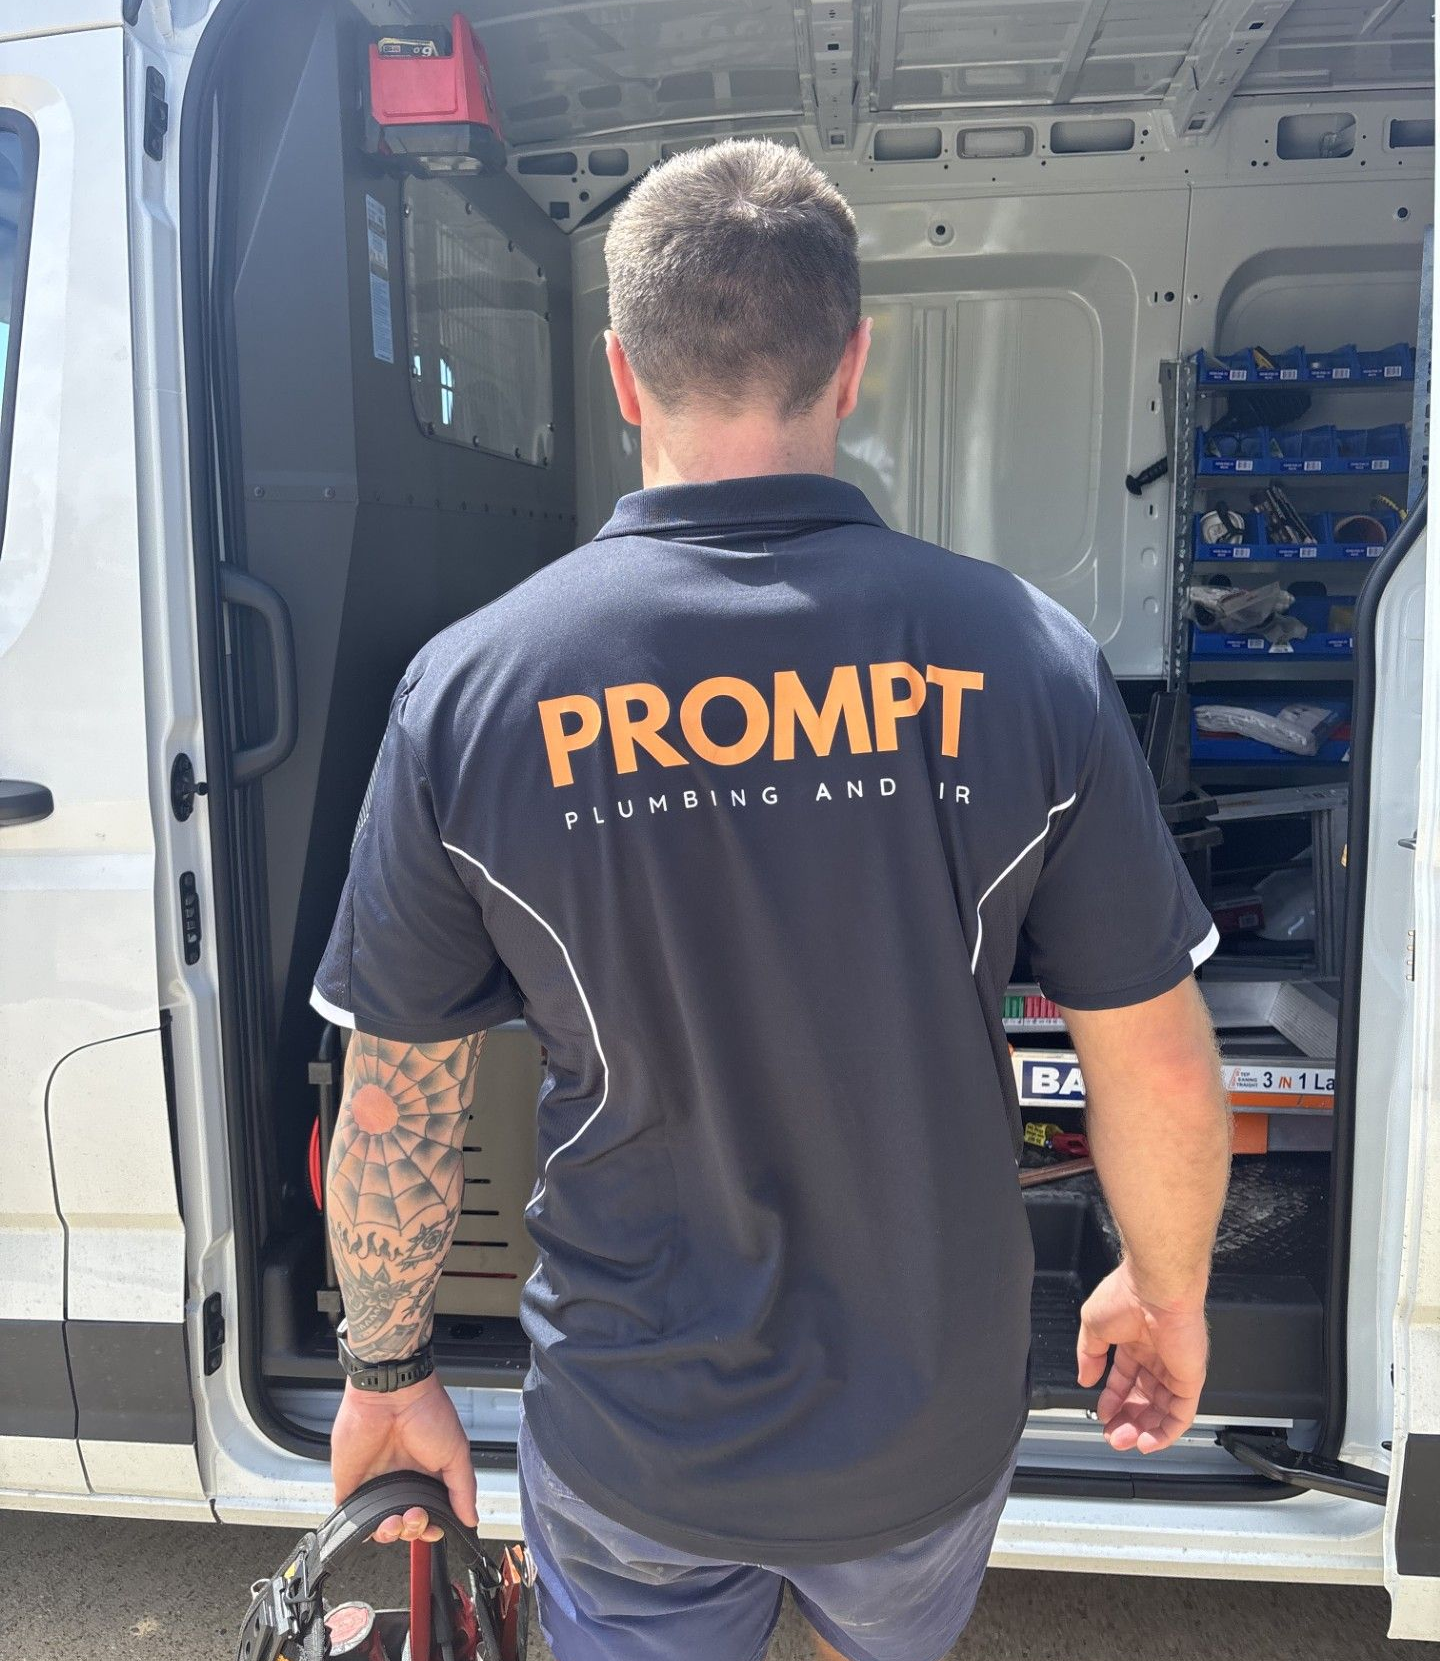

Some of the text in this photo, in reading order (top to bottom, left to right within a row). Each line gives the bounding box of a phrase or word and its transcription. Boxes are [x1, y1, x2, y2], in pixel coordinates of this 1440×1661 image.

[538, 661, 984, 788] PROMPT
[564, 779, 971, 830] PLUMBING AND IR
[1263, 1071, 1273, 1089] 3
[1298, 1072, 1307, 1090] 1
